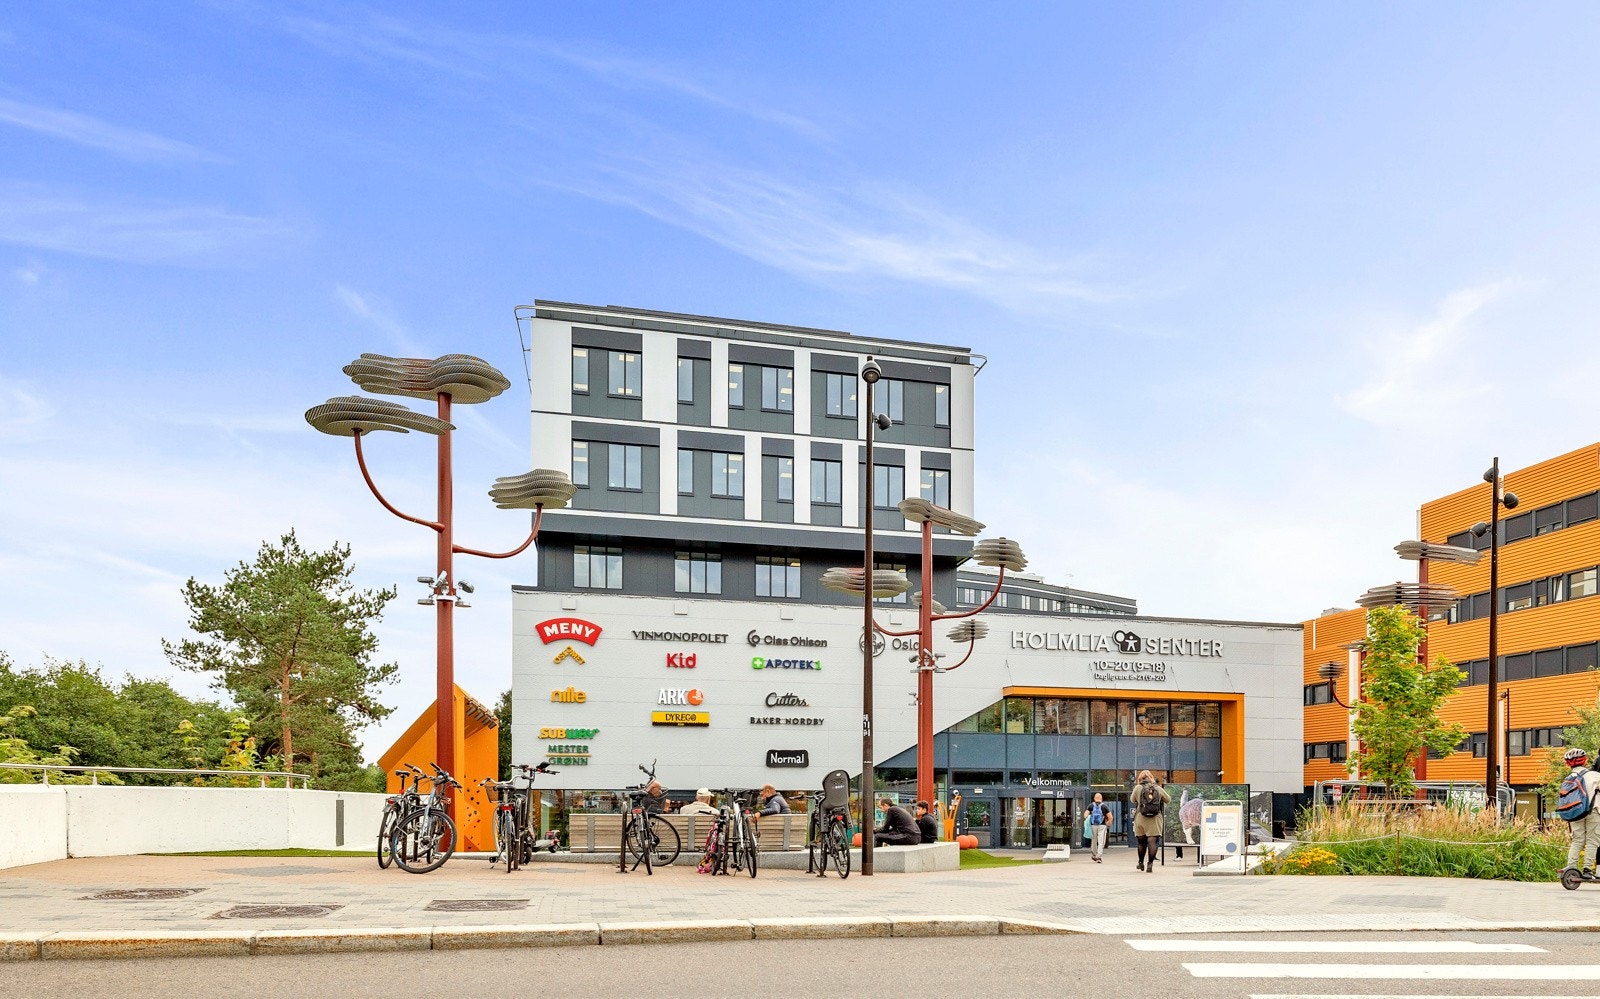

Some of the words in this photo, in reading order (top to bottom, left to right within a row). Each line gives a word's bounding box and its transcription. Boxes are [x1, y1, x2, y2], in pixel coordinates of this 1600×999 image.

[543, 622, 595, 638] MENY
[632, 630, 729, 643] VINMONOPOLET
[764, 635, 788, 645] Clas
[790, 636, 827, 647] Ohlson
[1011, 630, 1111, 653] HOLMLIA
[1146, 637, 1224, 657] SENTER
[666, 653, 697, 668] Kid
[765, 659, 814, 669] APOTEK
[551, 687, 587, 703] nille
[658, 689, 687, 705] ARK
[785, 717, 824, 725] NORDBY
[538, 727, 600, 739] SUBWAY
[548, 745, 589, 753] MESTER
[548, 757, 588, 765] GRØNN
[770, 752, 805, 764] Normal
[1025, 777, 1072, 786] Velkommen
